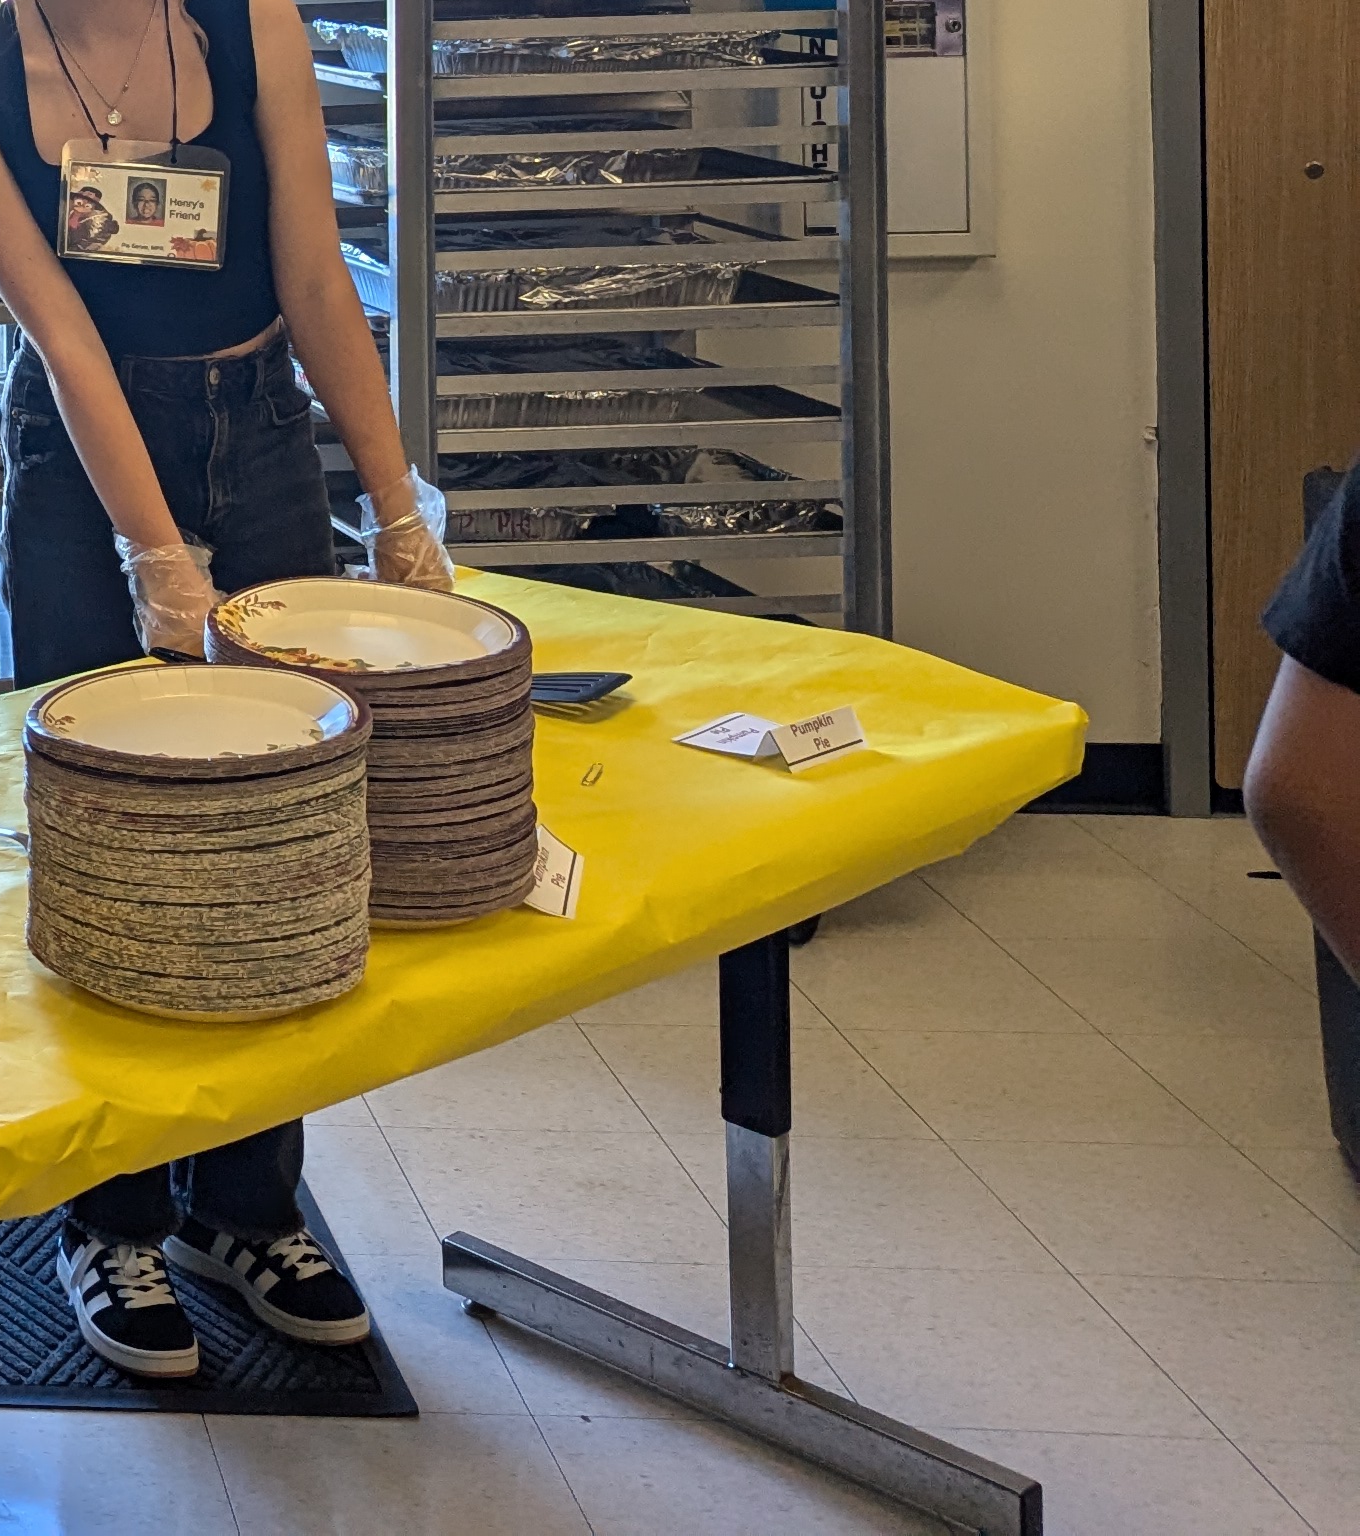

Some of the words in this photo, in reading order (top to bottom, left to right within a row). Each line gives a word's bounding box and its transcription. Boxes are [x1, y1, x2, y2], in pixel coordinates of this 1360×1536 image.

[169, 197, 205, 209] Henry's
[169, 209, 201, 221] Friend
[790, 713, 835, 737] Pumpkin
[813, 736, 831, 751] Pie
[534, 846, 550, 889] umpkin
[550, 872, 567, 889] Pie
